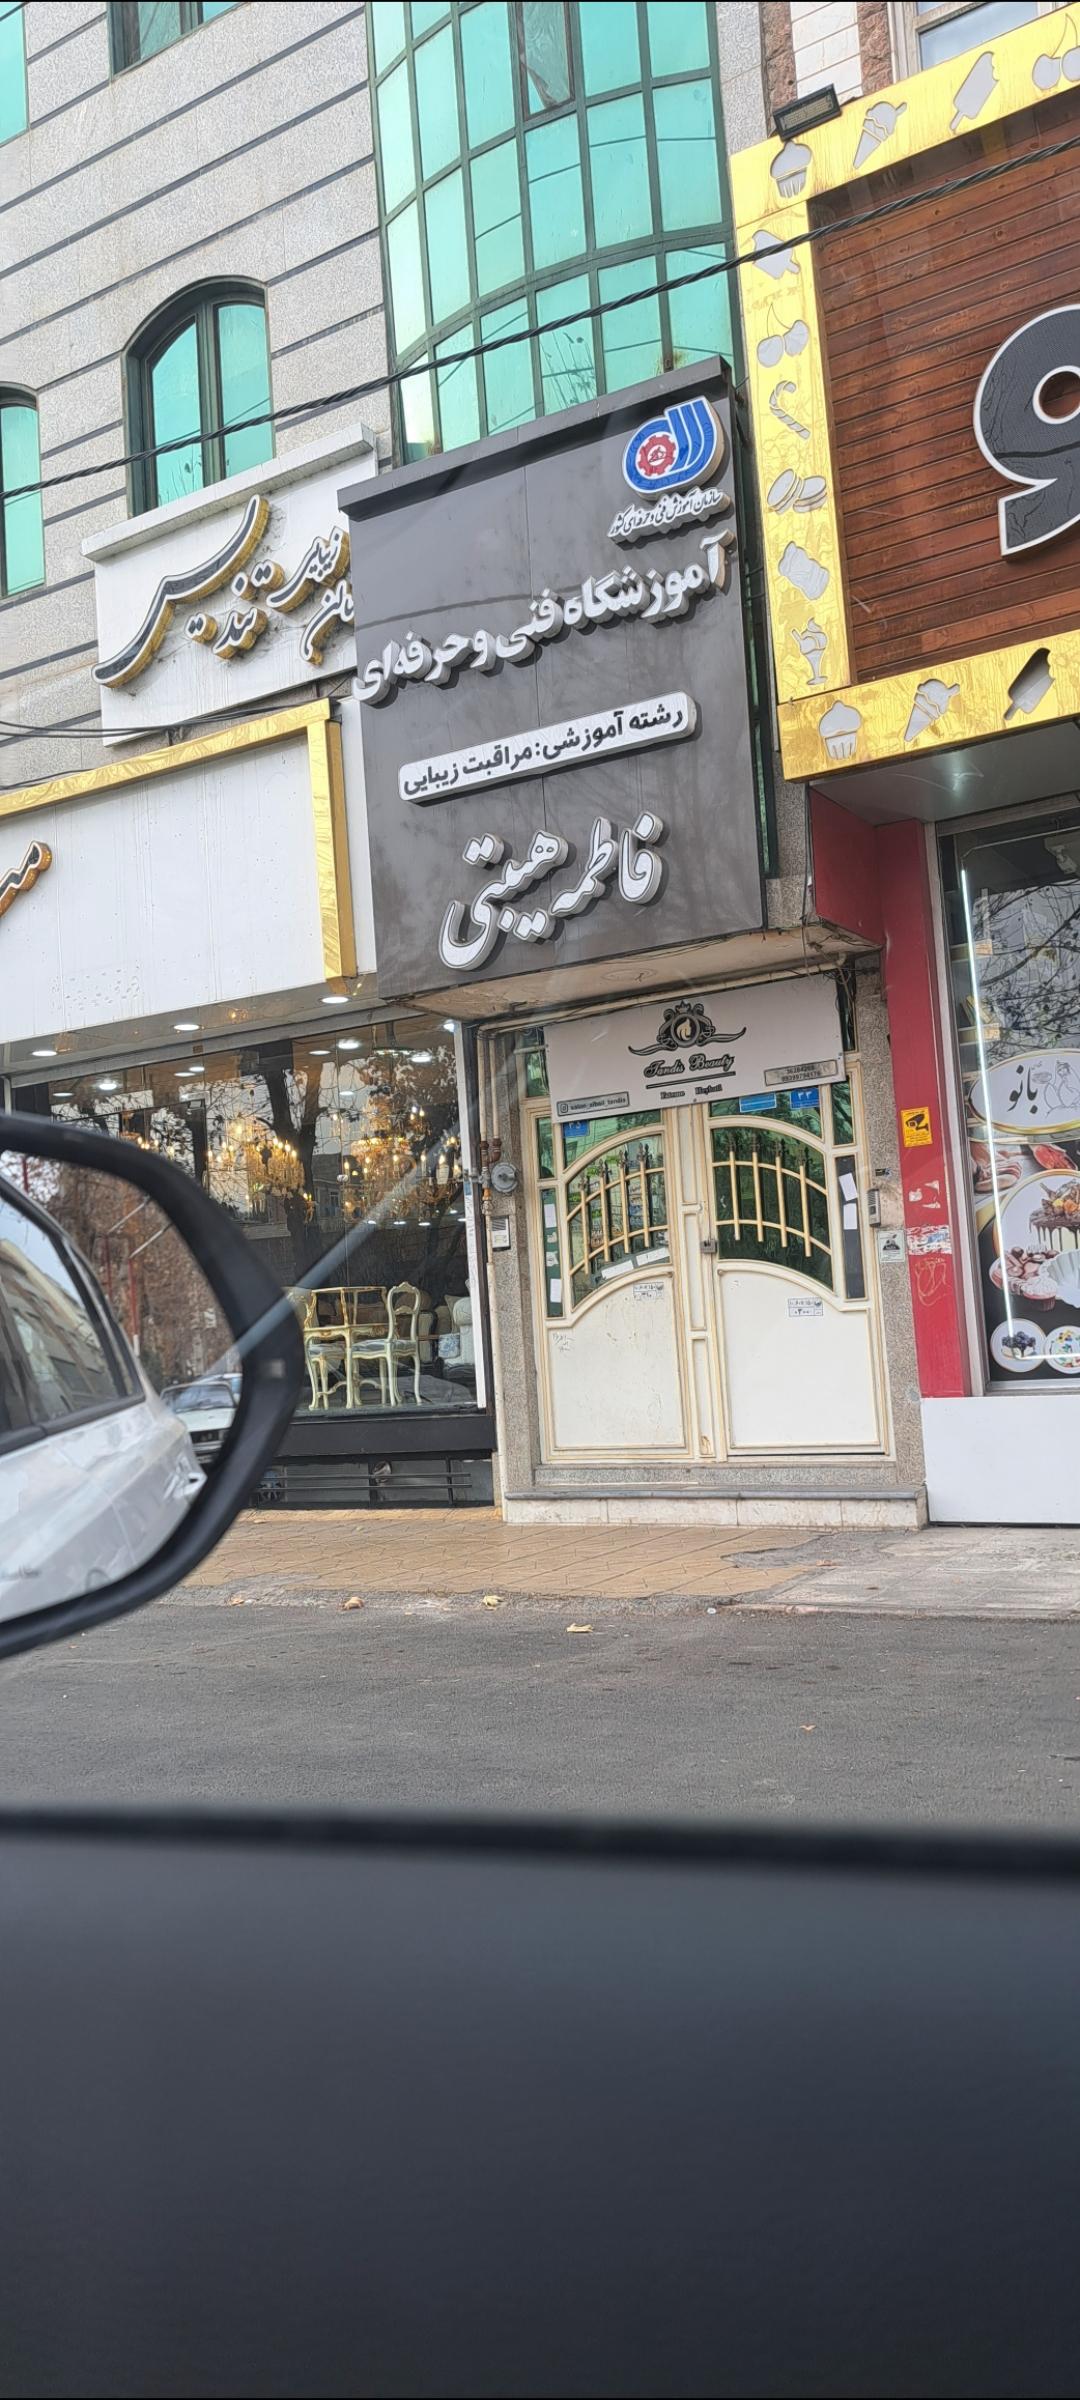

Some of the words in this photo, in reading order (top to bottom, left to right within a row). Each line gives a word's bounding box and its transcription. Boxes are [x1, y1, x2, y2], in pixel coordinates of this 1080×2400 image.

[610, 504, 633, 535] کشور
[666, 490, 697, 521] آموزش
[693, 489, 722, 512] سازمان
[91, 495, 285, 688] تندیس
[563, 530, 733, 628] آموزشگاه
[300, 580, 354, 666] الن
[495, 588, 564, 661] فنی
[629, 703, 683, 730] رشته
[403, 765, 459, 796] زیبایی
[462, 744, 532, 776] مراقبت
[550, 811, 662, 918] فاطمه
[438, 829, 567, 970] هیبتی
[644, 1058, 685, 1078] Tandis
[689, 1053, 735, 1072] Beauty
[1007, 1064, 1038, 1114] بانو
